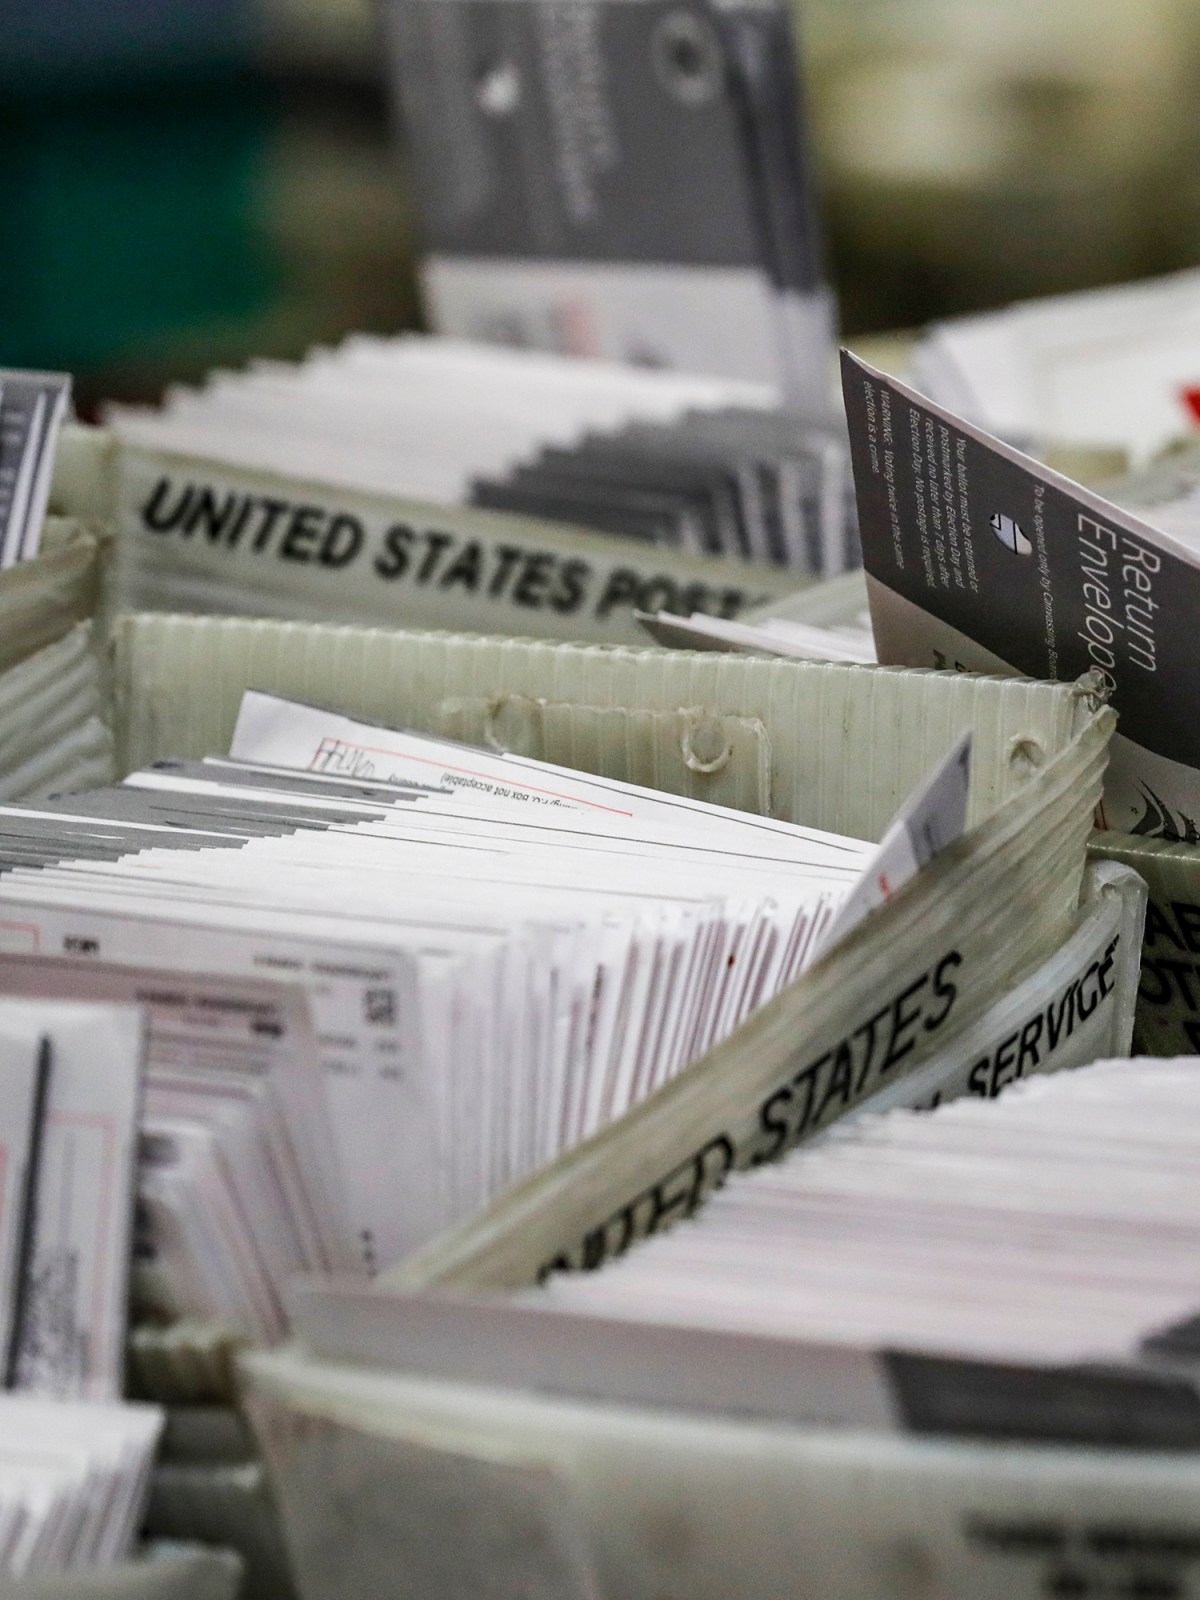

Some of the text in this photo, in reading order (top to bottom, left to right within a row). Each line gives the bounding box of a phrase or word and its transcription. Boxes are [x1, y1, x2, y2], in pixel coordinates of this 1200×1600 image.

[863, 380, 876, 423] election
[868, 423, 878, 434] is
[868, 434, 877, 443] a
[909, 408, 921, 453] Election
[925, 417, 938, 466] received
[880, 389, 905, 570] WARNING: Voting twice in the same
[928, 463, 937, 479] no
[915, 476, 925, 493] No
[929, 480, 940, 506] later
[1034, 484, 1045, 497] To
[914, 491, 928, 535] postage
[932, 506, 942, 530] than
[938, 424, 966, 589] postmarked by Election Day and
[956, 438, 979, 593] Your ballot must be returned or
[1034, 498, 1045, 513] be
[143, 476, 365, 570] UNITED
[373, 521, 592, 613] STATES
[921, 534, 930, 545] is
[1033, 514, 1048, 555] opened
[934, 539, 946, 563] days
[939, 563, 950, 588] after
[1037, 553, 1050, 577] only
[1040, 577, 1051, 591] by
[1121, 537, 1161, 672] Return
[1043, 592, 1056, 648] Canvassing
[440, 771, 492, 793] acceptable)
[493, 786, 511, 797] not
[967, 933, 1120, 1100] SERVICE
[751, 950, 962, 1165] STATES
